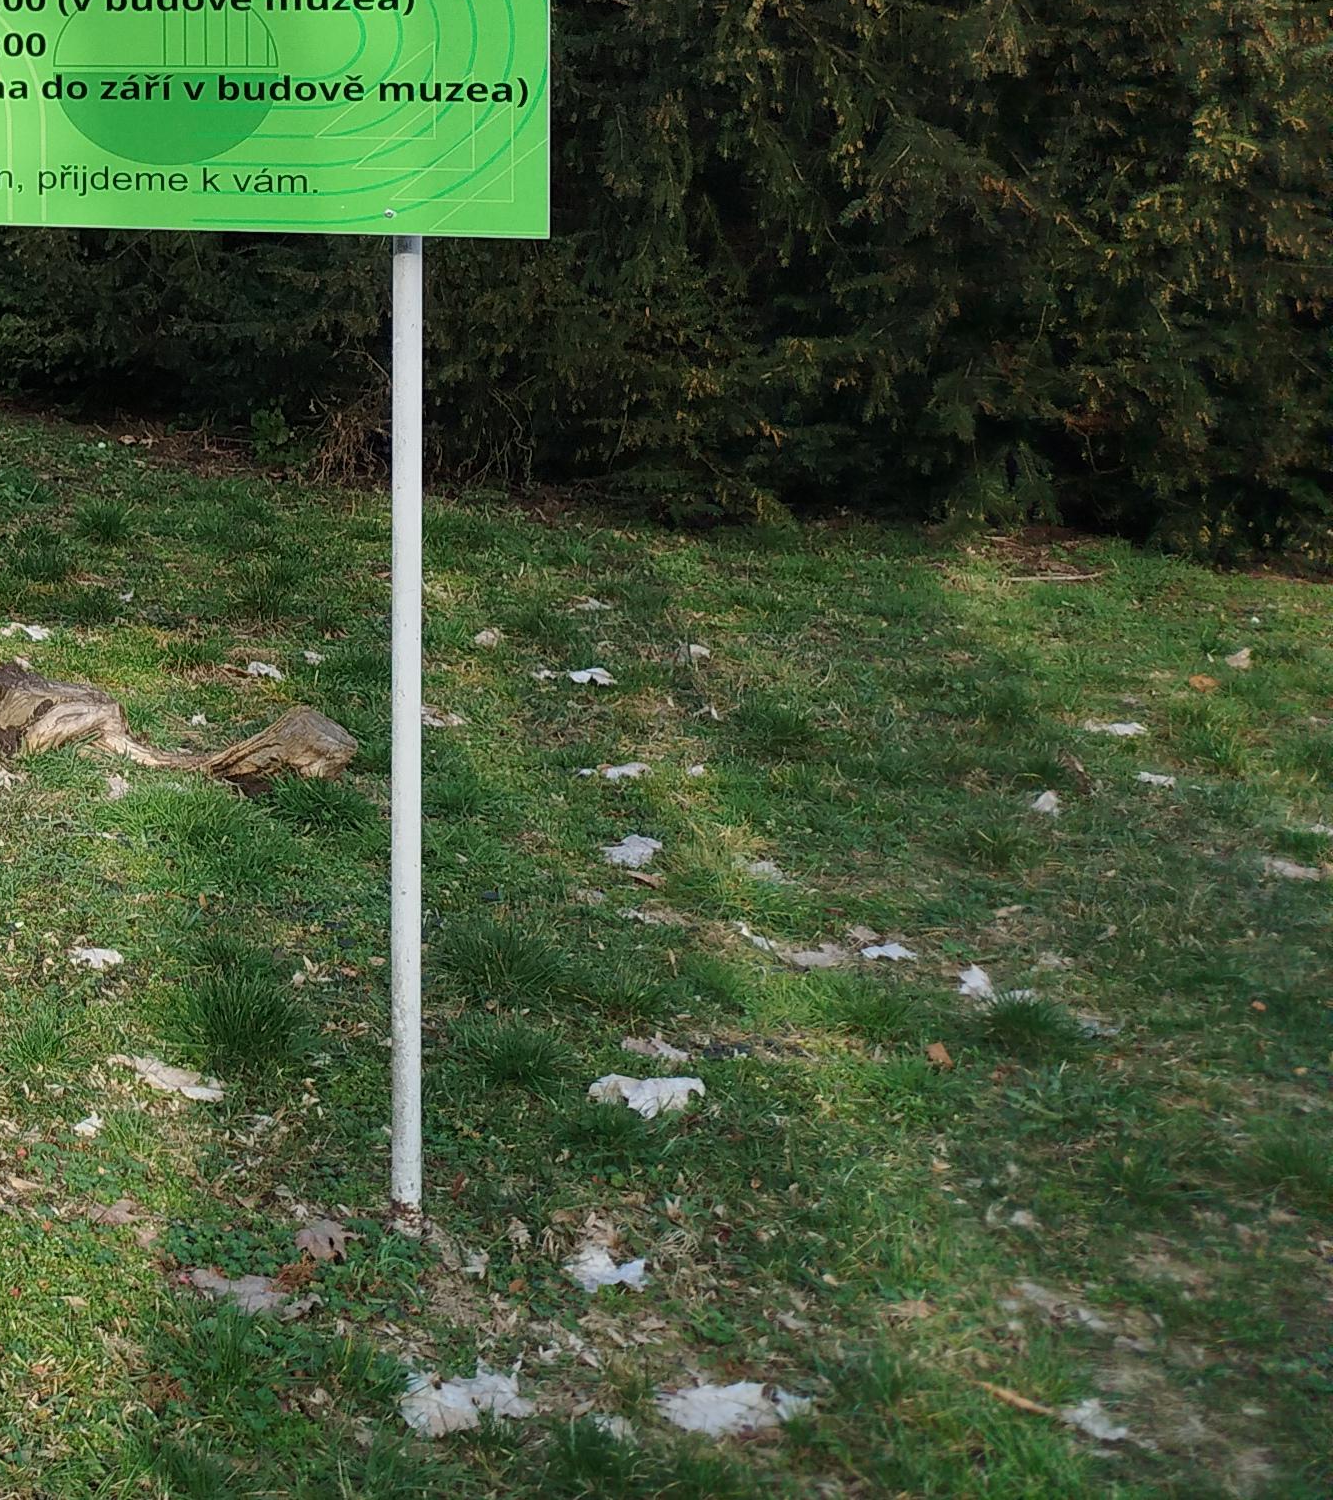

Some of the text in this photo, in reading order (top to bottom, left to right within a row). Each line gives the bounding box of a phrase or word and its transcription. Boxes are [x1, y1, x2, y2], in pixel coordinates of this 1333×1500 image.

[41, 74, 88, 100] do
[100, 74, 172, 101] září
[183, 81, 206, 101] v
[218, 74, 365, 102] budově
[379, 77, 528, 108] muzea)
[38, 165, 189, 197] přijdeme
[202, 167, 221, 192] k
[233, 168, 319, 194] vám.
